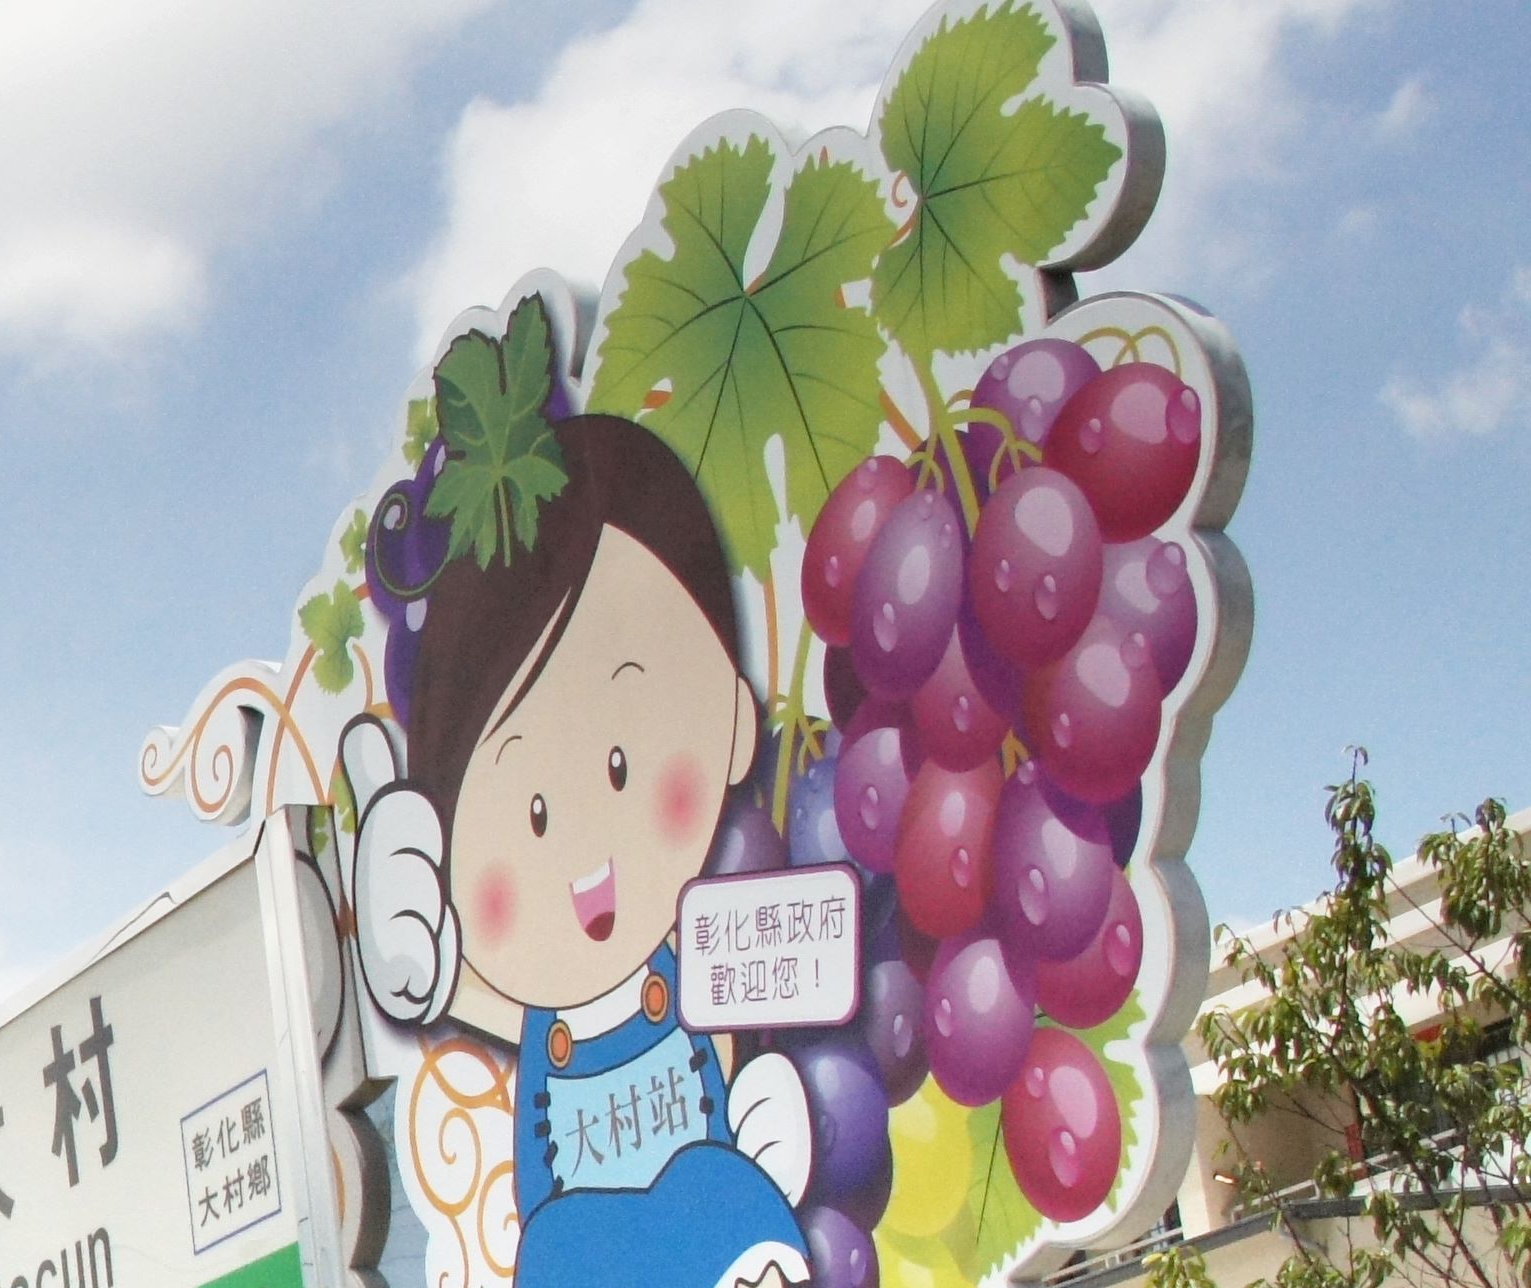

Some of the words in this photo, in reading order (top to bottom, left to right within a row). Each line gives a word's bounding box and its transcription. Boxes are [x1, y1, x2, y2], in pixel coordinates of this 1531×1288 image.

[693, 896, 847, 957] 彰化縣政府
[191, 1097, 266, 1172] 彰化縣
[565, 1066, 689, 1178] 大村站
[198, 1154, 271, 1228] 大村鄉
